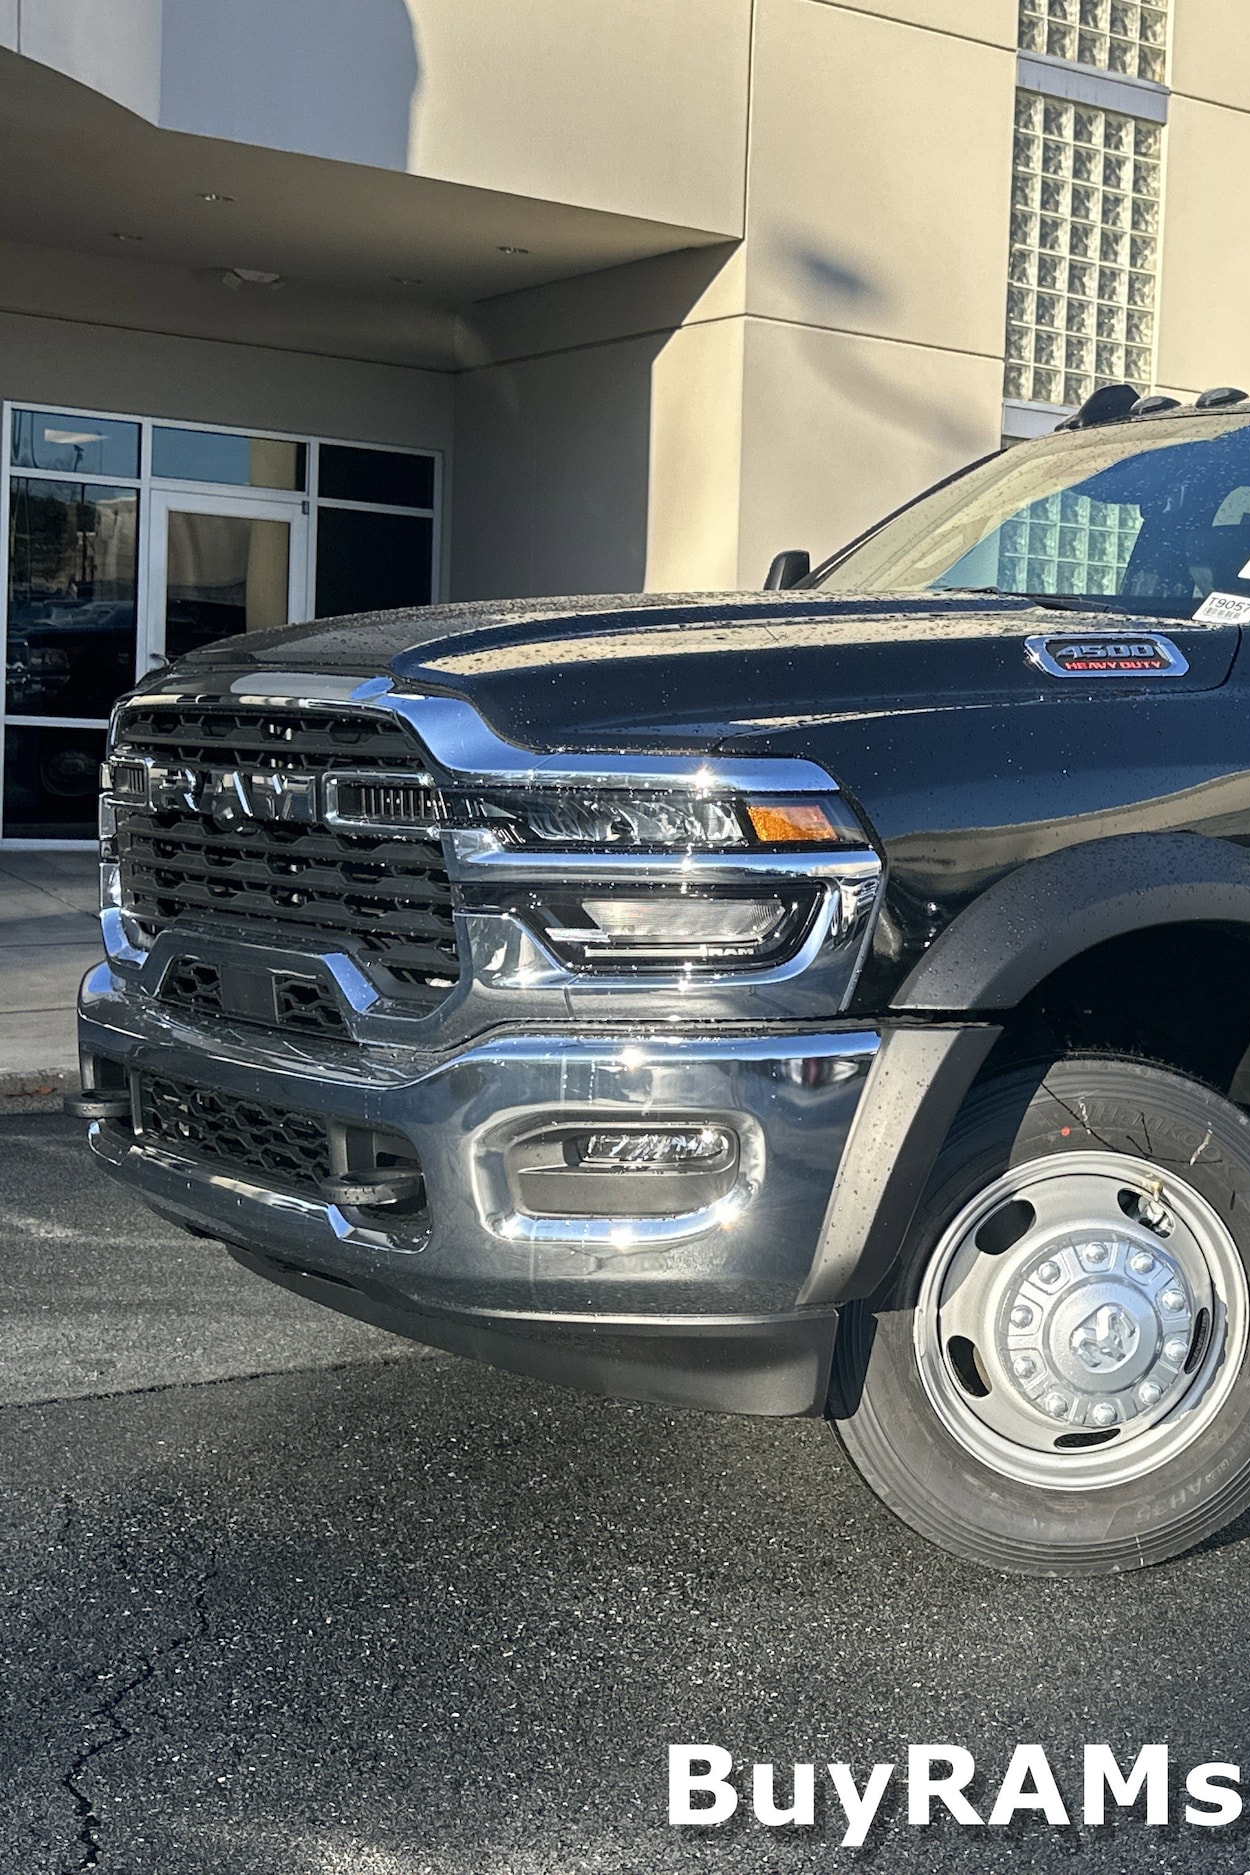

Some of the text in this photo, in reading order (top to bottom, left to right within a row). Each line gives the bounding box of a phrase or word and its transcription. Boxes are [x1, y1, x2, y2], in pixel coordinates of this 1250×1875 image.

[1056, 644, 1154, 659] 4500
[1065, 660, 1162, 670] HEAVY DUTY
[707, 948, 755, 957] RAM
